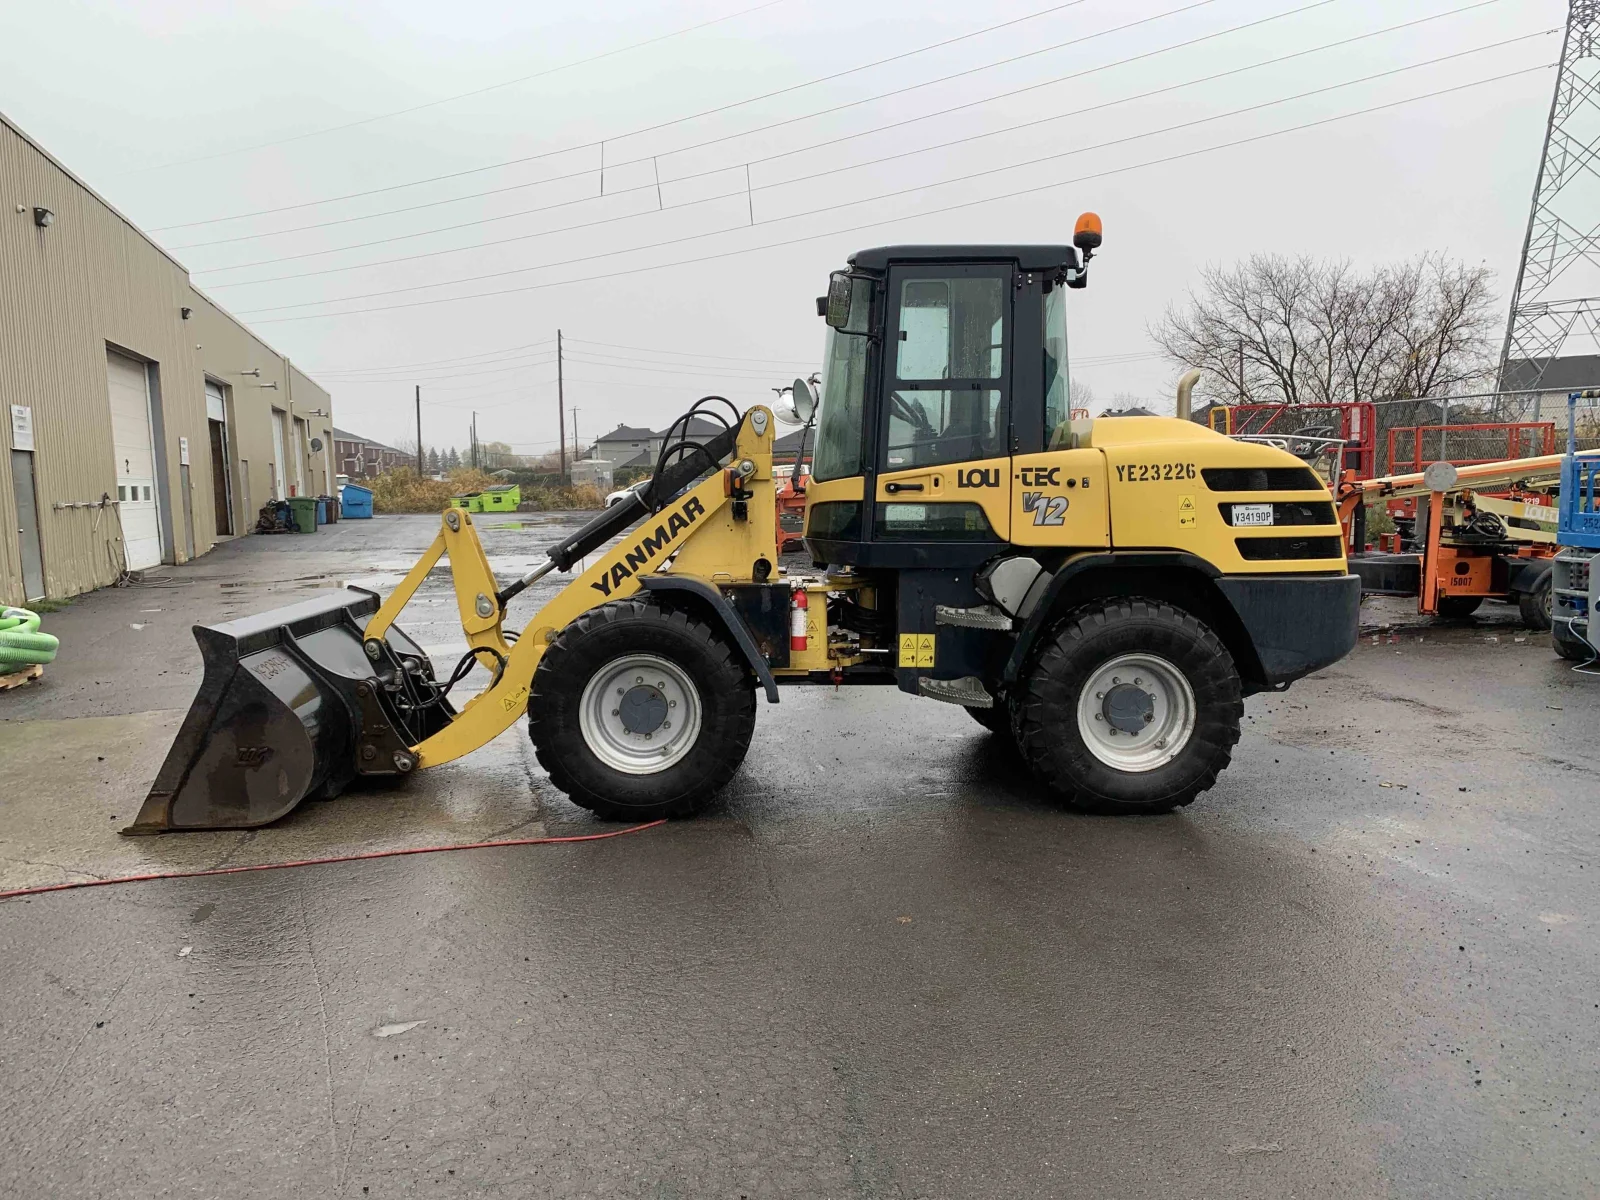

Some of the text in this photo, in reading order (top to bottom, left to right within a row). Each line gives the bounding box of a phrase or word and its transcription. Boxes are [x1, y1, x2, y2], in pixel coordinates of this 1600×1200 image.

[1116, 463, 1196, 482] YE23226
[1022, 491, 1069, 526] V12
[1235, 511, 1271, 522] V34190P
[1583, 517, 1600, 529] 252
[590, 496, 705, 597] YANMAR
[1450, 577, 1473, 586] 15007
